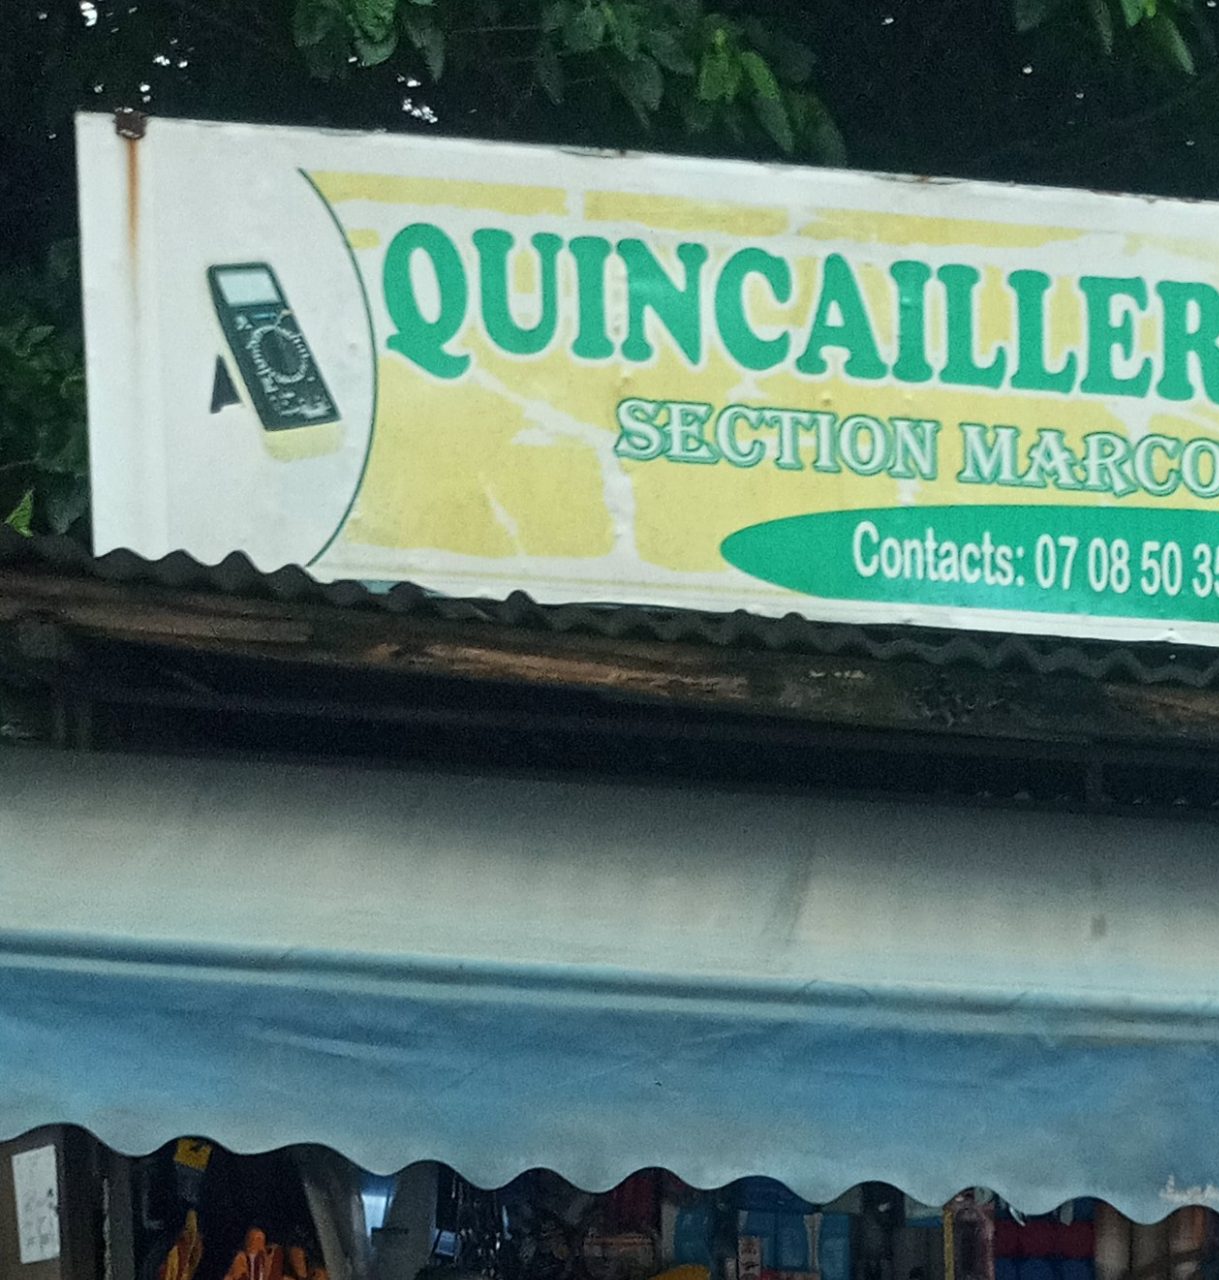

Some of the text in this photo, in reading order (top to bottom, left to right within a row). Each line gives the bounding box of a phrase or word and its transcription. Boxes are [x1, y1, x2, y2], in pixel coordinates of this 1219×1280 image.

[615, 398, 939, 479] SECTION
[852, 521, 1025, 587] Contacts:
[1035, 534, 1078, 589] 07
[1088, 538, 1131, 593] 08
[1141, 541, 1184, 596] 50
